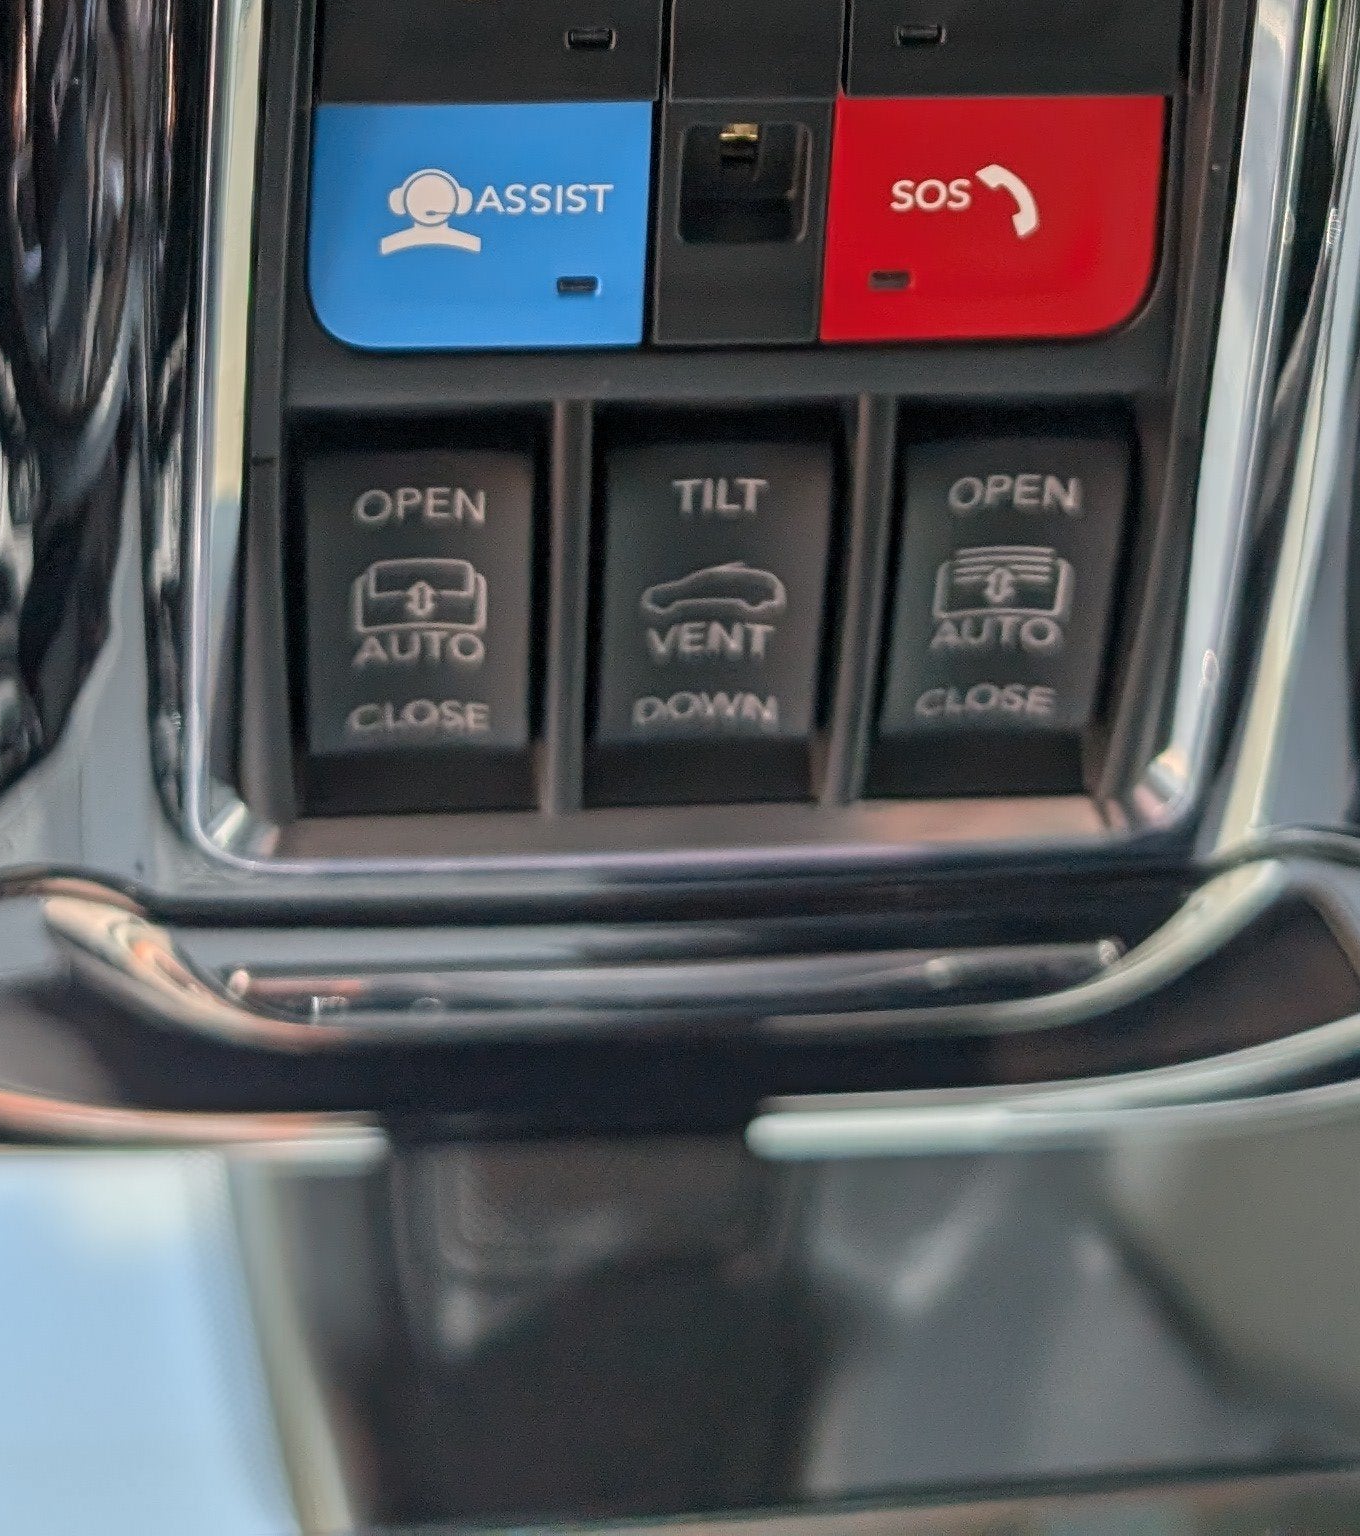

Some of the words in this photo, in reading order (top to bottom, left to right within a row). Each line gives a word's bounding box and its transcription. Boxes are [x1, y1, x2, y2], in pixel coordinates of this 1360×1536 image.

[475, 183, 614, 215] ASSIST
[890, 178, 972, 211] SOS
[355, 488, 487, 524] OPEN
[672, 478, 768, 513] TILT
[948, 474, 1080, 512] OPEN
[355, 632, 485, 664] AUTO
[649, 623, 774, 656] VENT
[930, 619, 1060, 650] AUTO
[350, 699, 490, 733] CLOSE
[633, 692, 777, 726] DOWN
[916, 683, 1055, 717] CLOSE
